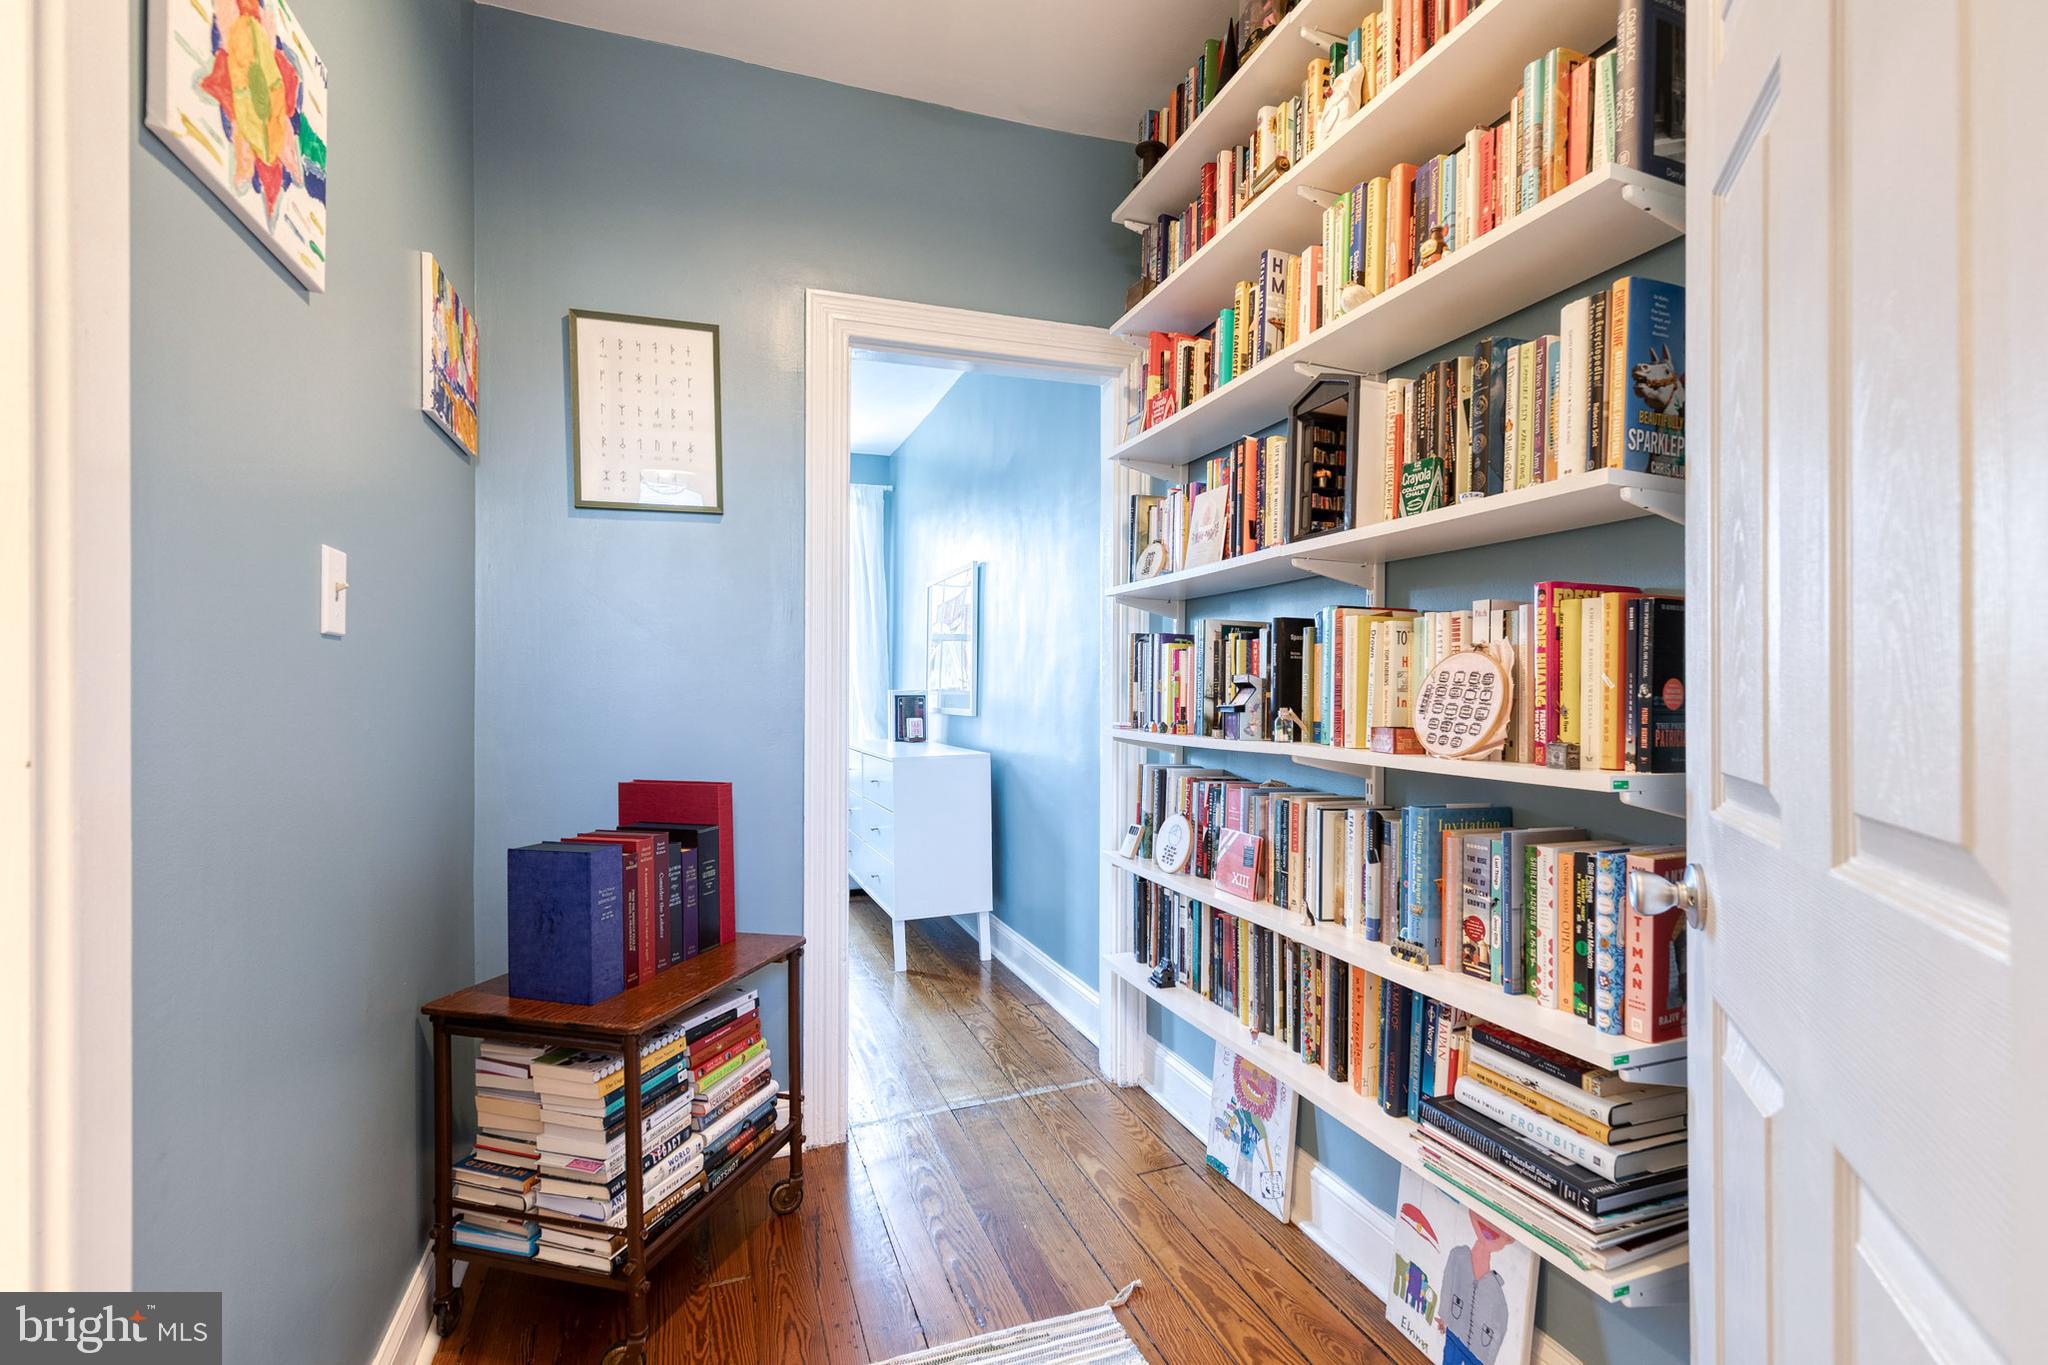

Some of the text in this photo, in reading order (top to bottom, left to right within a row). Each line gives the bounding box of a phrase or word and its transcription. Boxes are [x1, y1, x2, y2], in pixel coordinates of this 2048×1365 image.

[1593, 299, 1605, 382] The Encyclopedia
[1402, 468, 1432, 487] Crayola
[1651, 461, 1670, 474] CHRIS
[1451, 617, 1461, 643] MINOR
[1534, 606, 1548, 707] EDDIE HUANG
[1467, 855, 1487, 865] THE RISE
[1231, 872, 1249, 889] XIII
[1587, 875, 1595, 903] Pictures
[1561, 920, 1570, 954] OPEN
[1587, 918, 1595, 938] Janet
[1426, 1025, 1435, 1056] Norway
[1438, 1021, 1449, 1060] JAPAN
[1482, 1100, 1505, 1116] TWILLEY
[1509, 1110, 1586, 1160] FROSTBITE
[651, 1136, 682, 1165] LEGACY
[667, 1146, 691, 1167] WORLD
[711, 1158, 740, 1189] HOTSHOT
